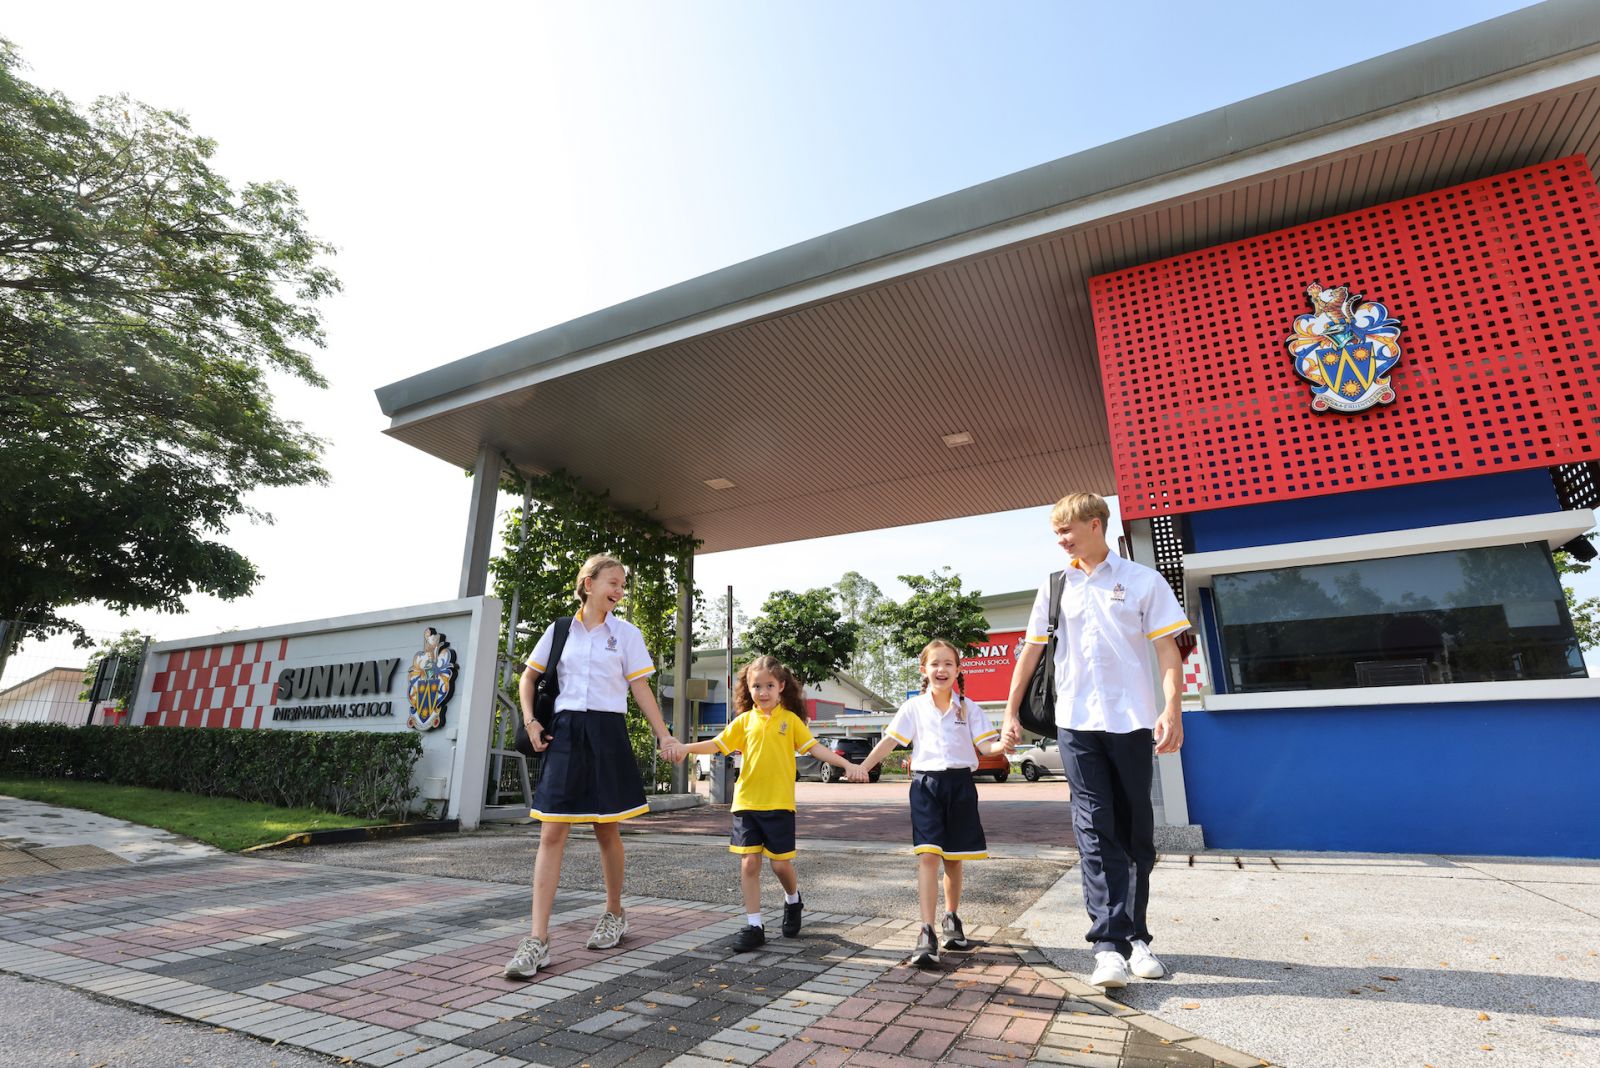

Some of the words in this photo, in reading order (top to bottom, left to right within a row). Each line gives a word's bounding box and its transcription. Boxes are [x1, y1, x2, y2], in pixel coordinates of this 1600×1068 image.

[960, 645, 1008, 659] WAY
[278, 658, 400, 699] SUNWAY
[273, 704, 347, 721] INTERNATIONAL
[348, 701, 394, 718] SCHOOL
